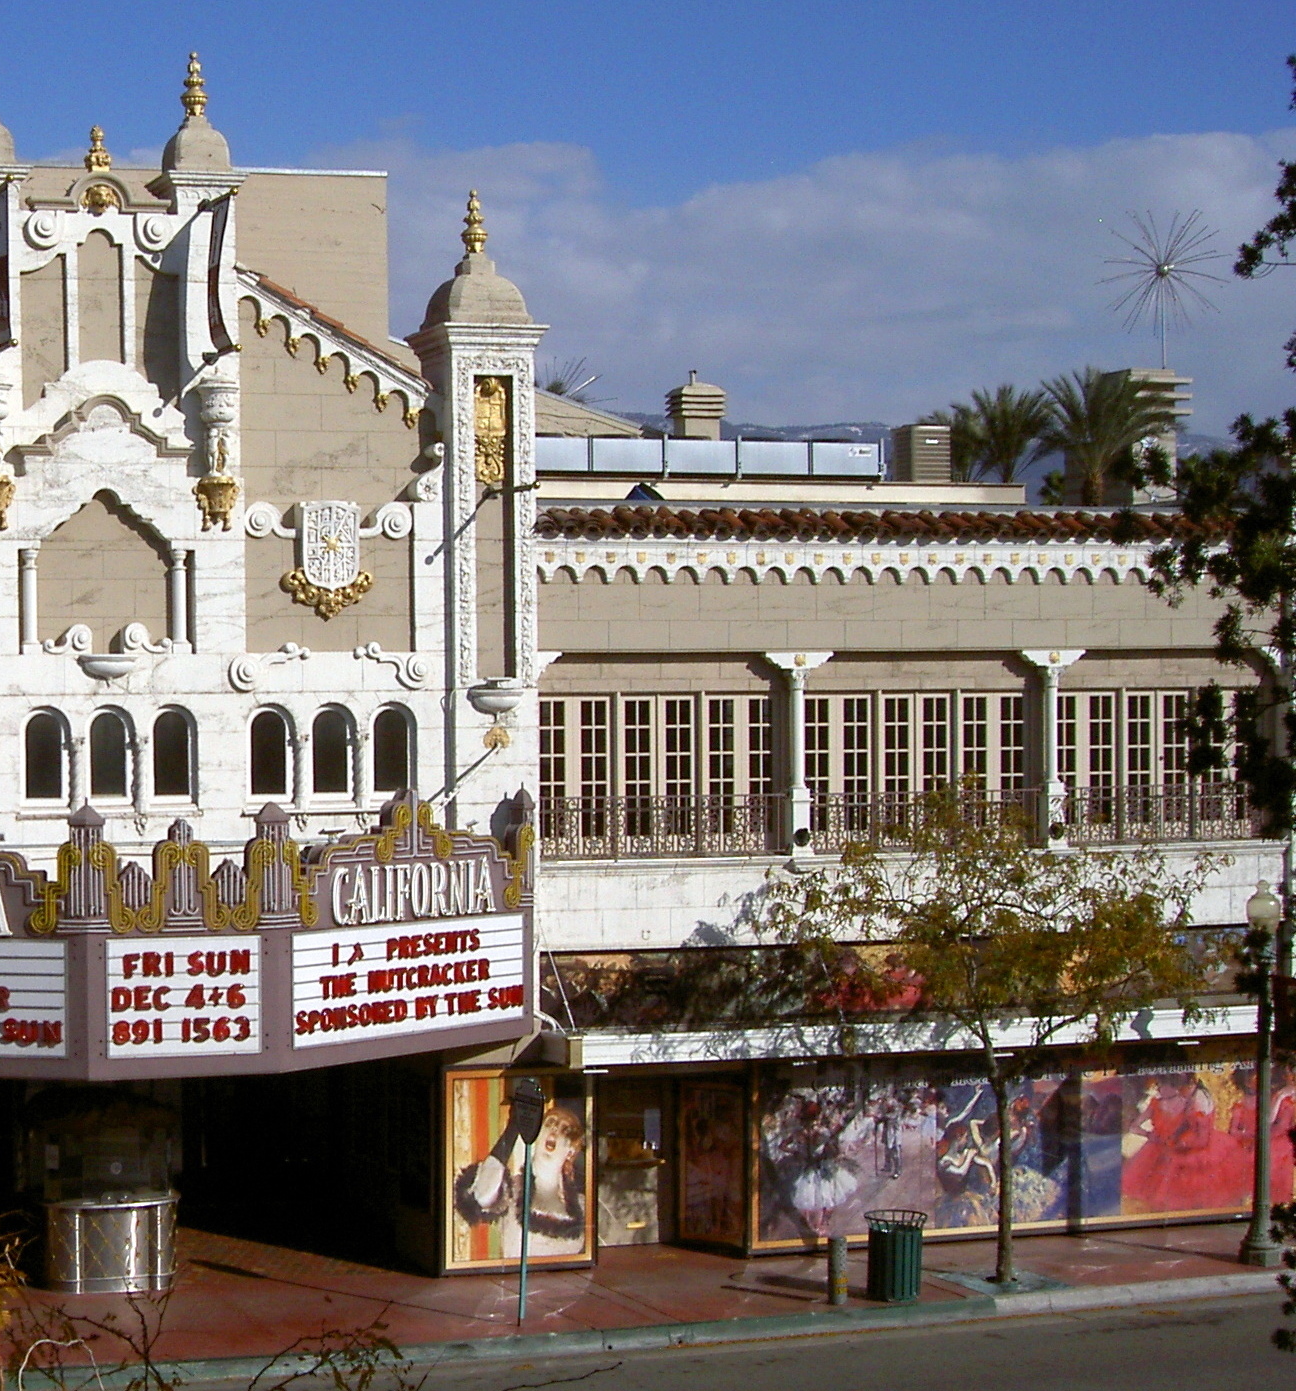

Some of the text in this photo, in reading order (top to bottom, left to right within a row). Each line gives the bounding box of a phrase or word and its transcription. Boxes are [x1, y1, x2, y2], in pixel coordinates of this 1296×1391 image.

[333, 855, 497, 926] CALIFORNIA
[386, 928, 481, 962] PRESENTS
[122, 949, 251, 980] FRI SUN
[319, 958, 491, 1000] THE NUTCRACKER
[111, 985, 172, 1012] DEC
[295, 984, 524, 1035] SPONSORED BY THE SUN
[0, 1017, 63, 1049] SUN
[112, 1015, 251, 1045] 891 1563
